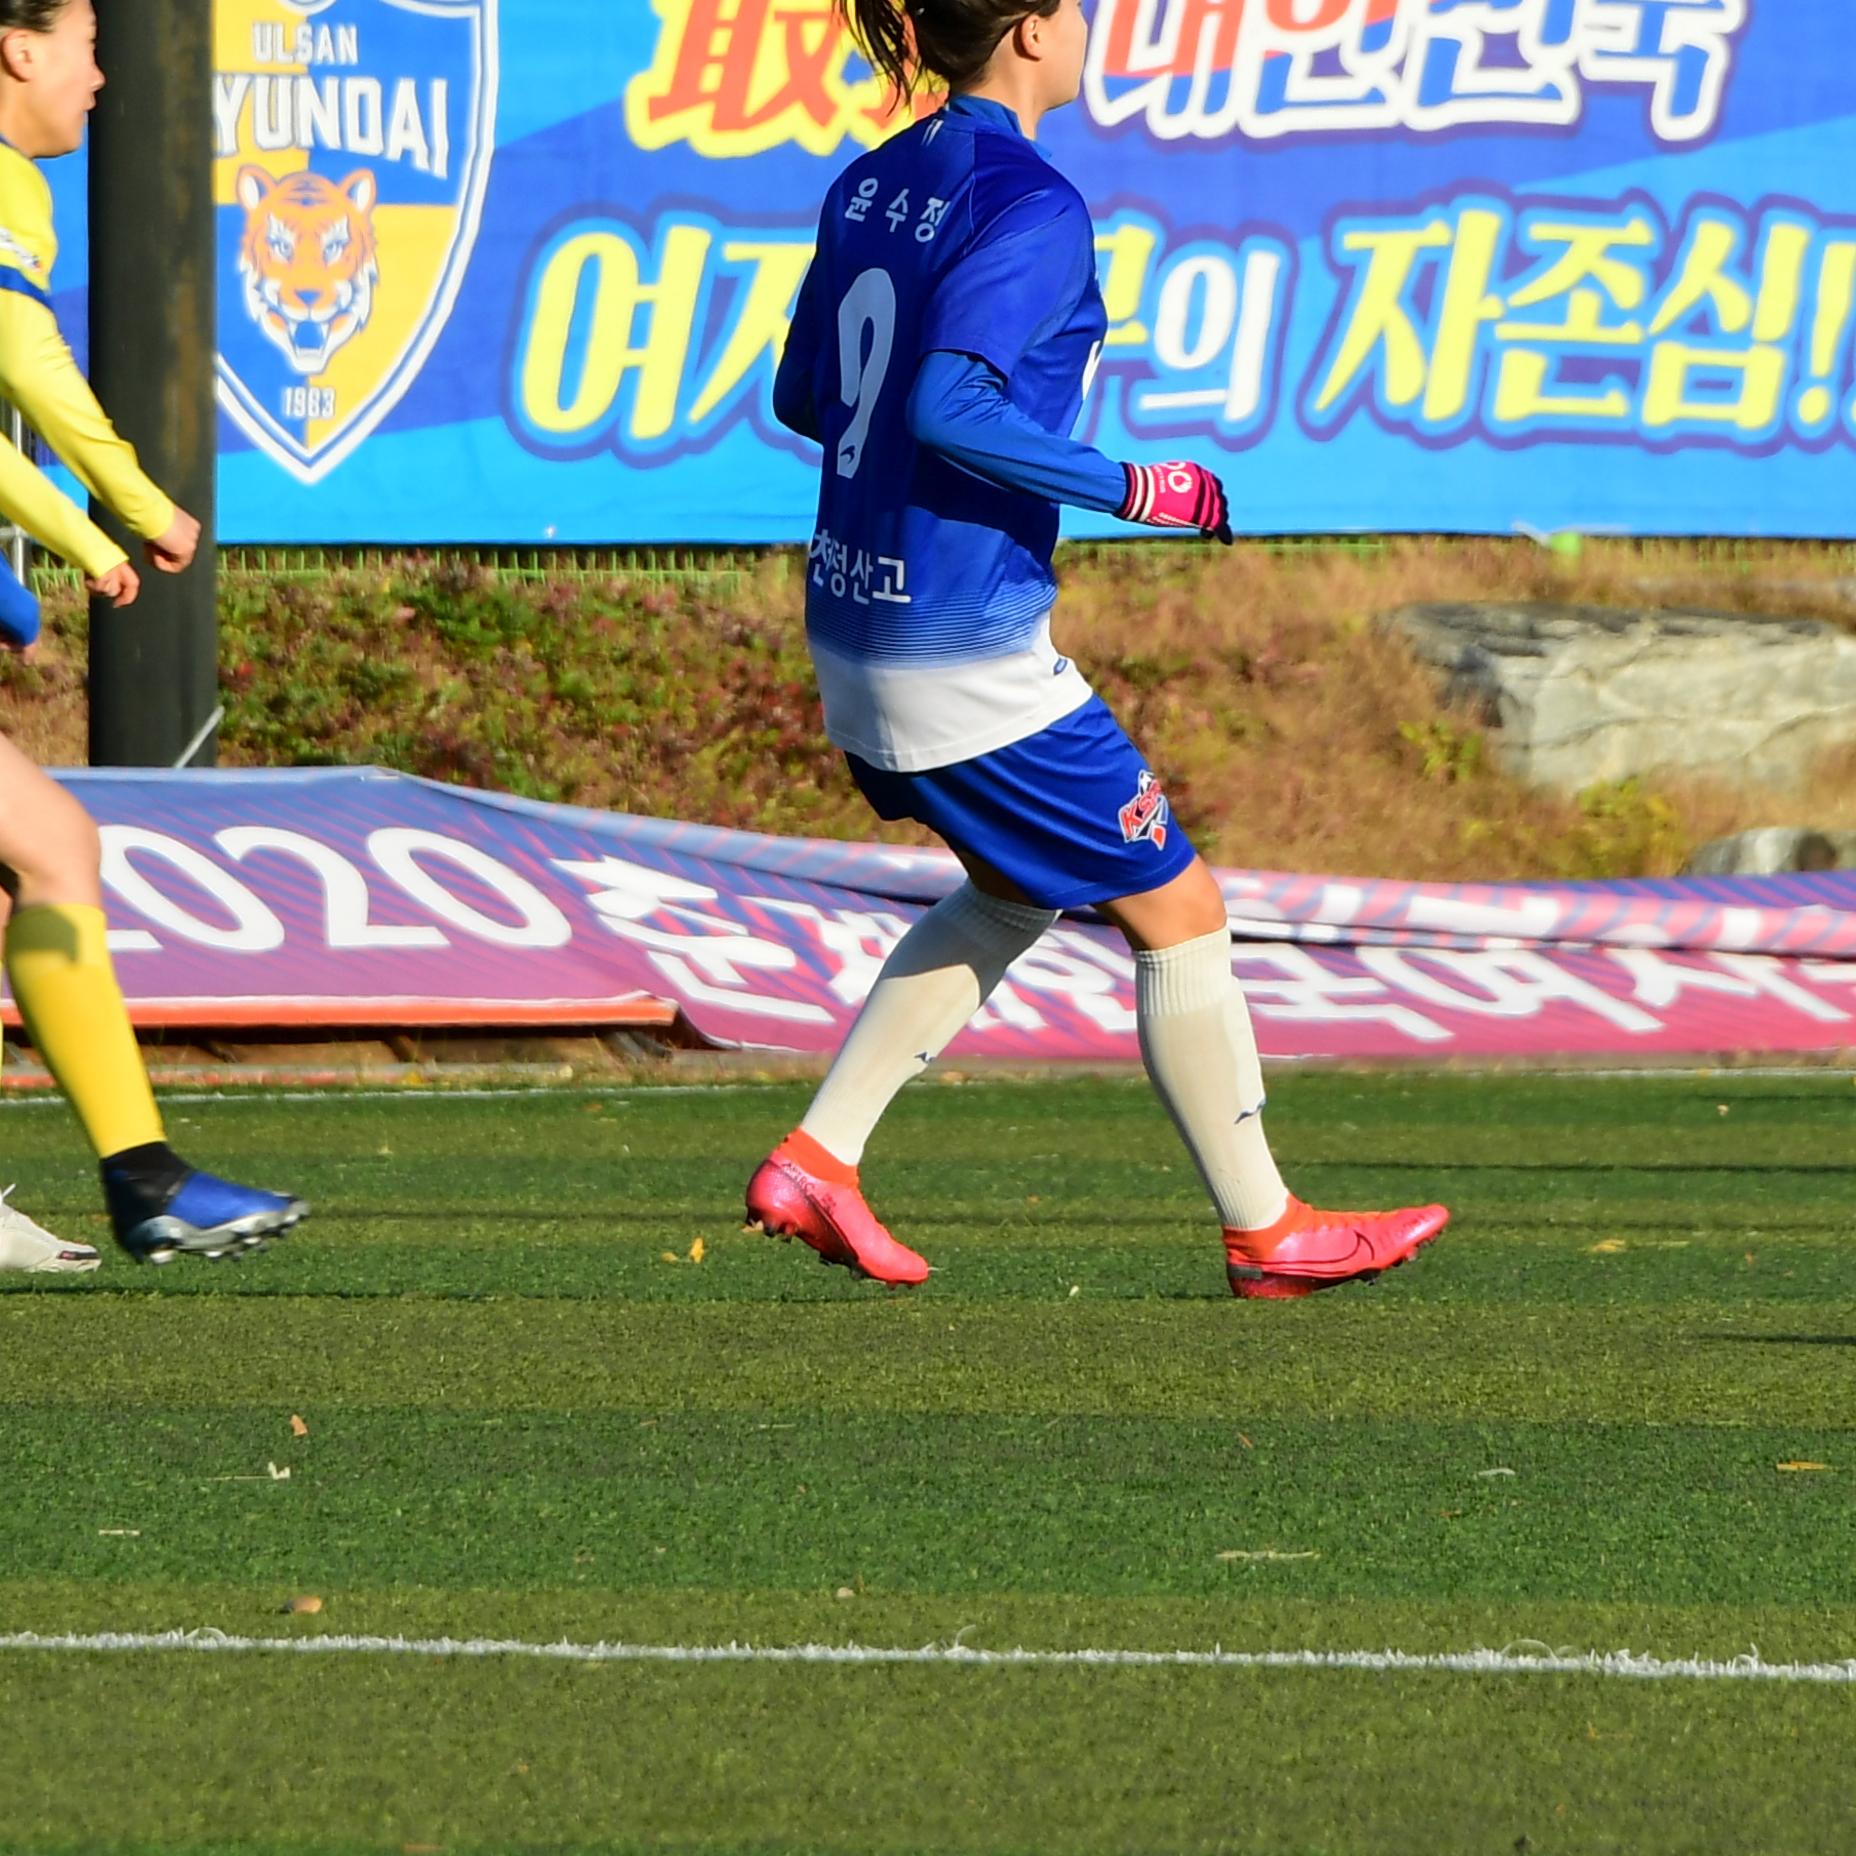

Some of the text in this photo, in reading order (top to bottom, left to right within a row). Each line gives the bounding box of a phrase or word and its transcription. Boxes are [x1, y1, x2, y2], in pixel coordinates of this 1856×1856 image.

[253, 22, 359, 66] ULSAN
[212, 74, 448, 180] YUNDAI
[844, 176, 952, 243] 윤수정
[837, 267, 896, 479] 9
[97, 822, 573, 952] 020
